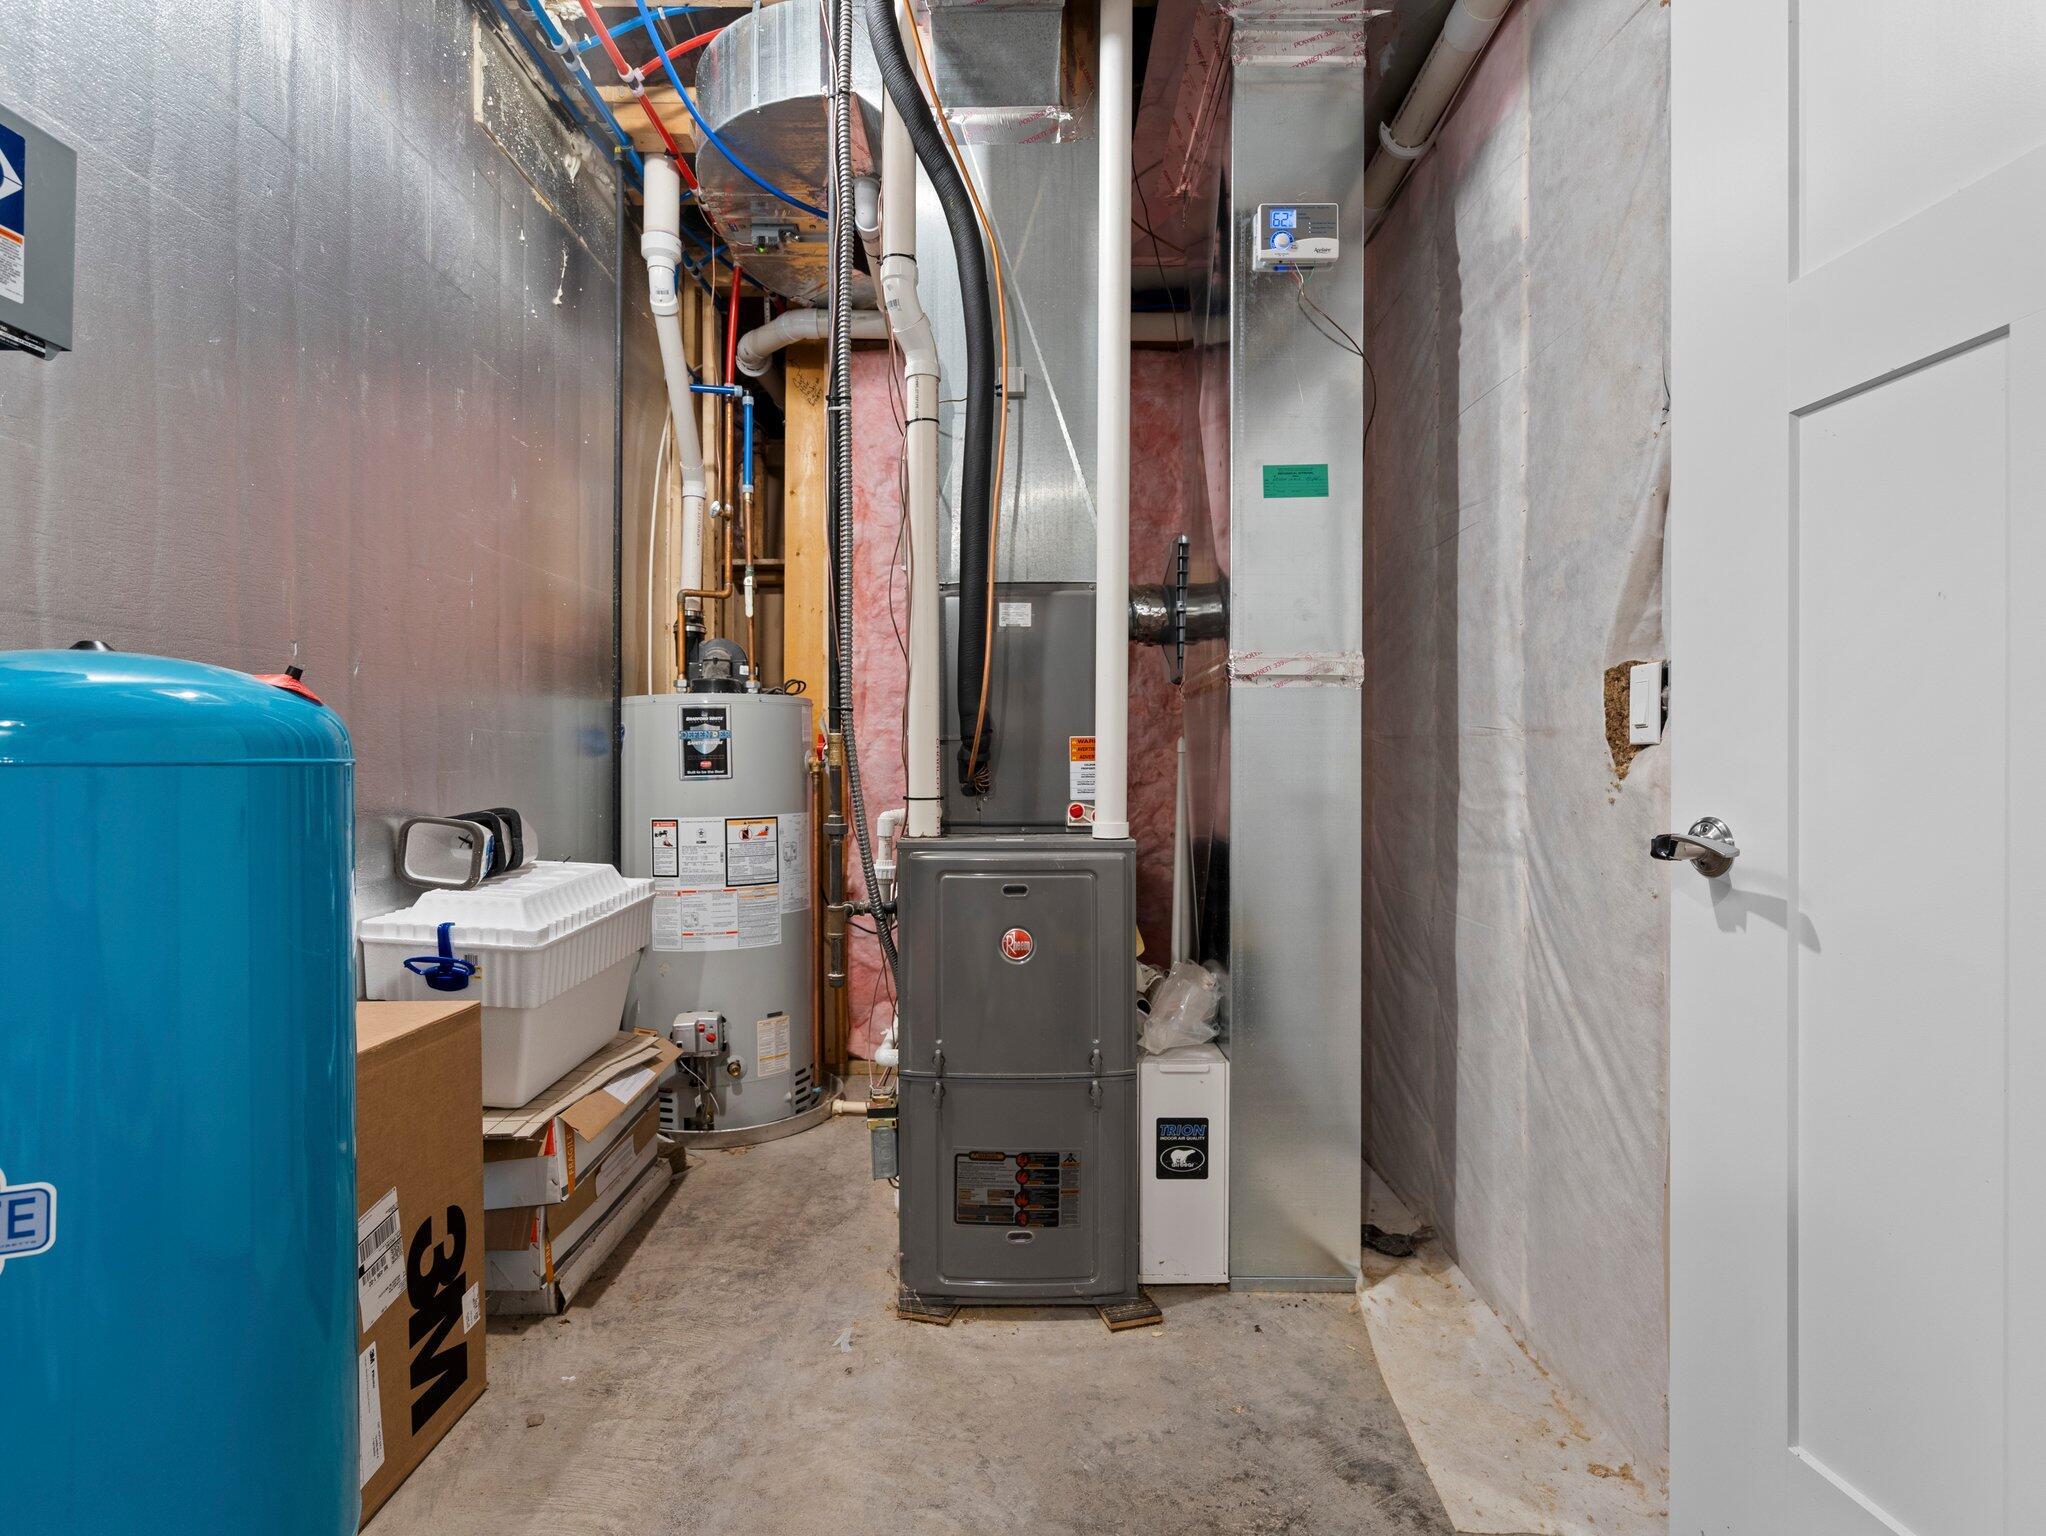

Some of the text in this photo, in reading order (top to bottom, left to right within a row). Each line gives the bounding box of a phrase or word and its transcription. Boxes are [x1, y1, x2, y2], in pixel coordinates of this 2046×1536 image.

[679, 730, 731, 739] DEFENDER
[1005, 932, 1031, 954] Rheem
[1160, 1124, 1207, 1136] TRION
[0, 1196, 36, 1240] E
[406, 1204, 468, 1437] 3M
